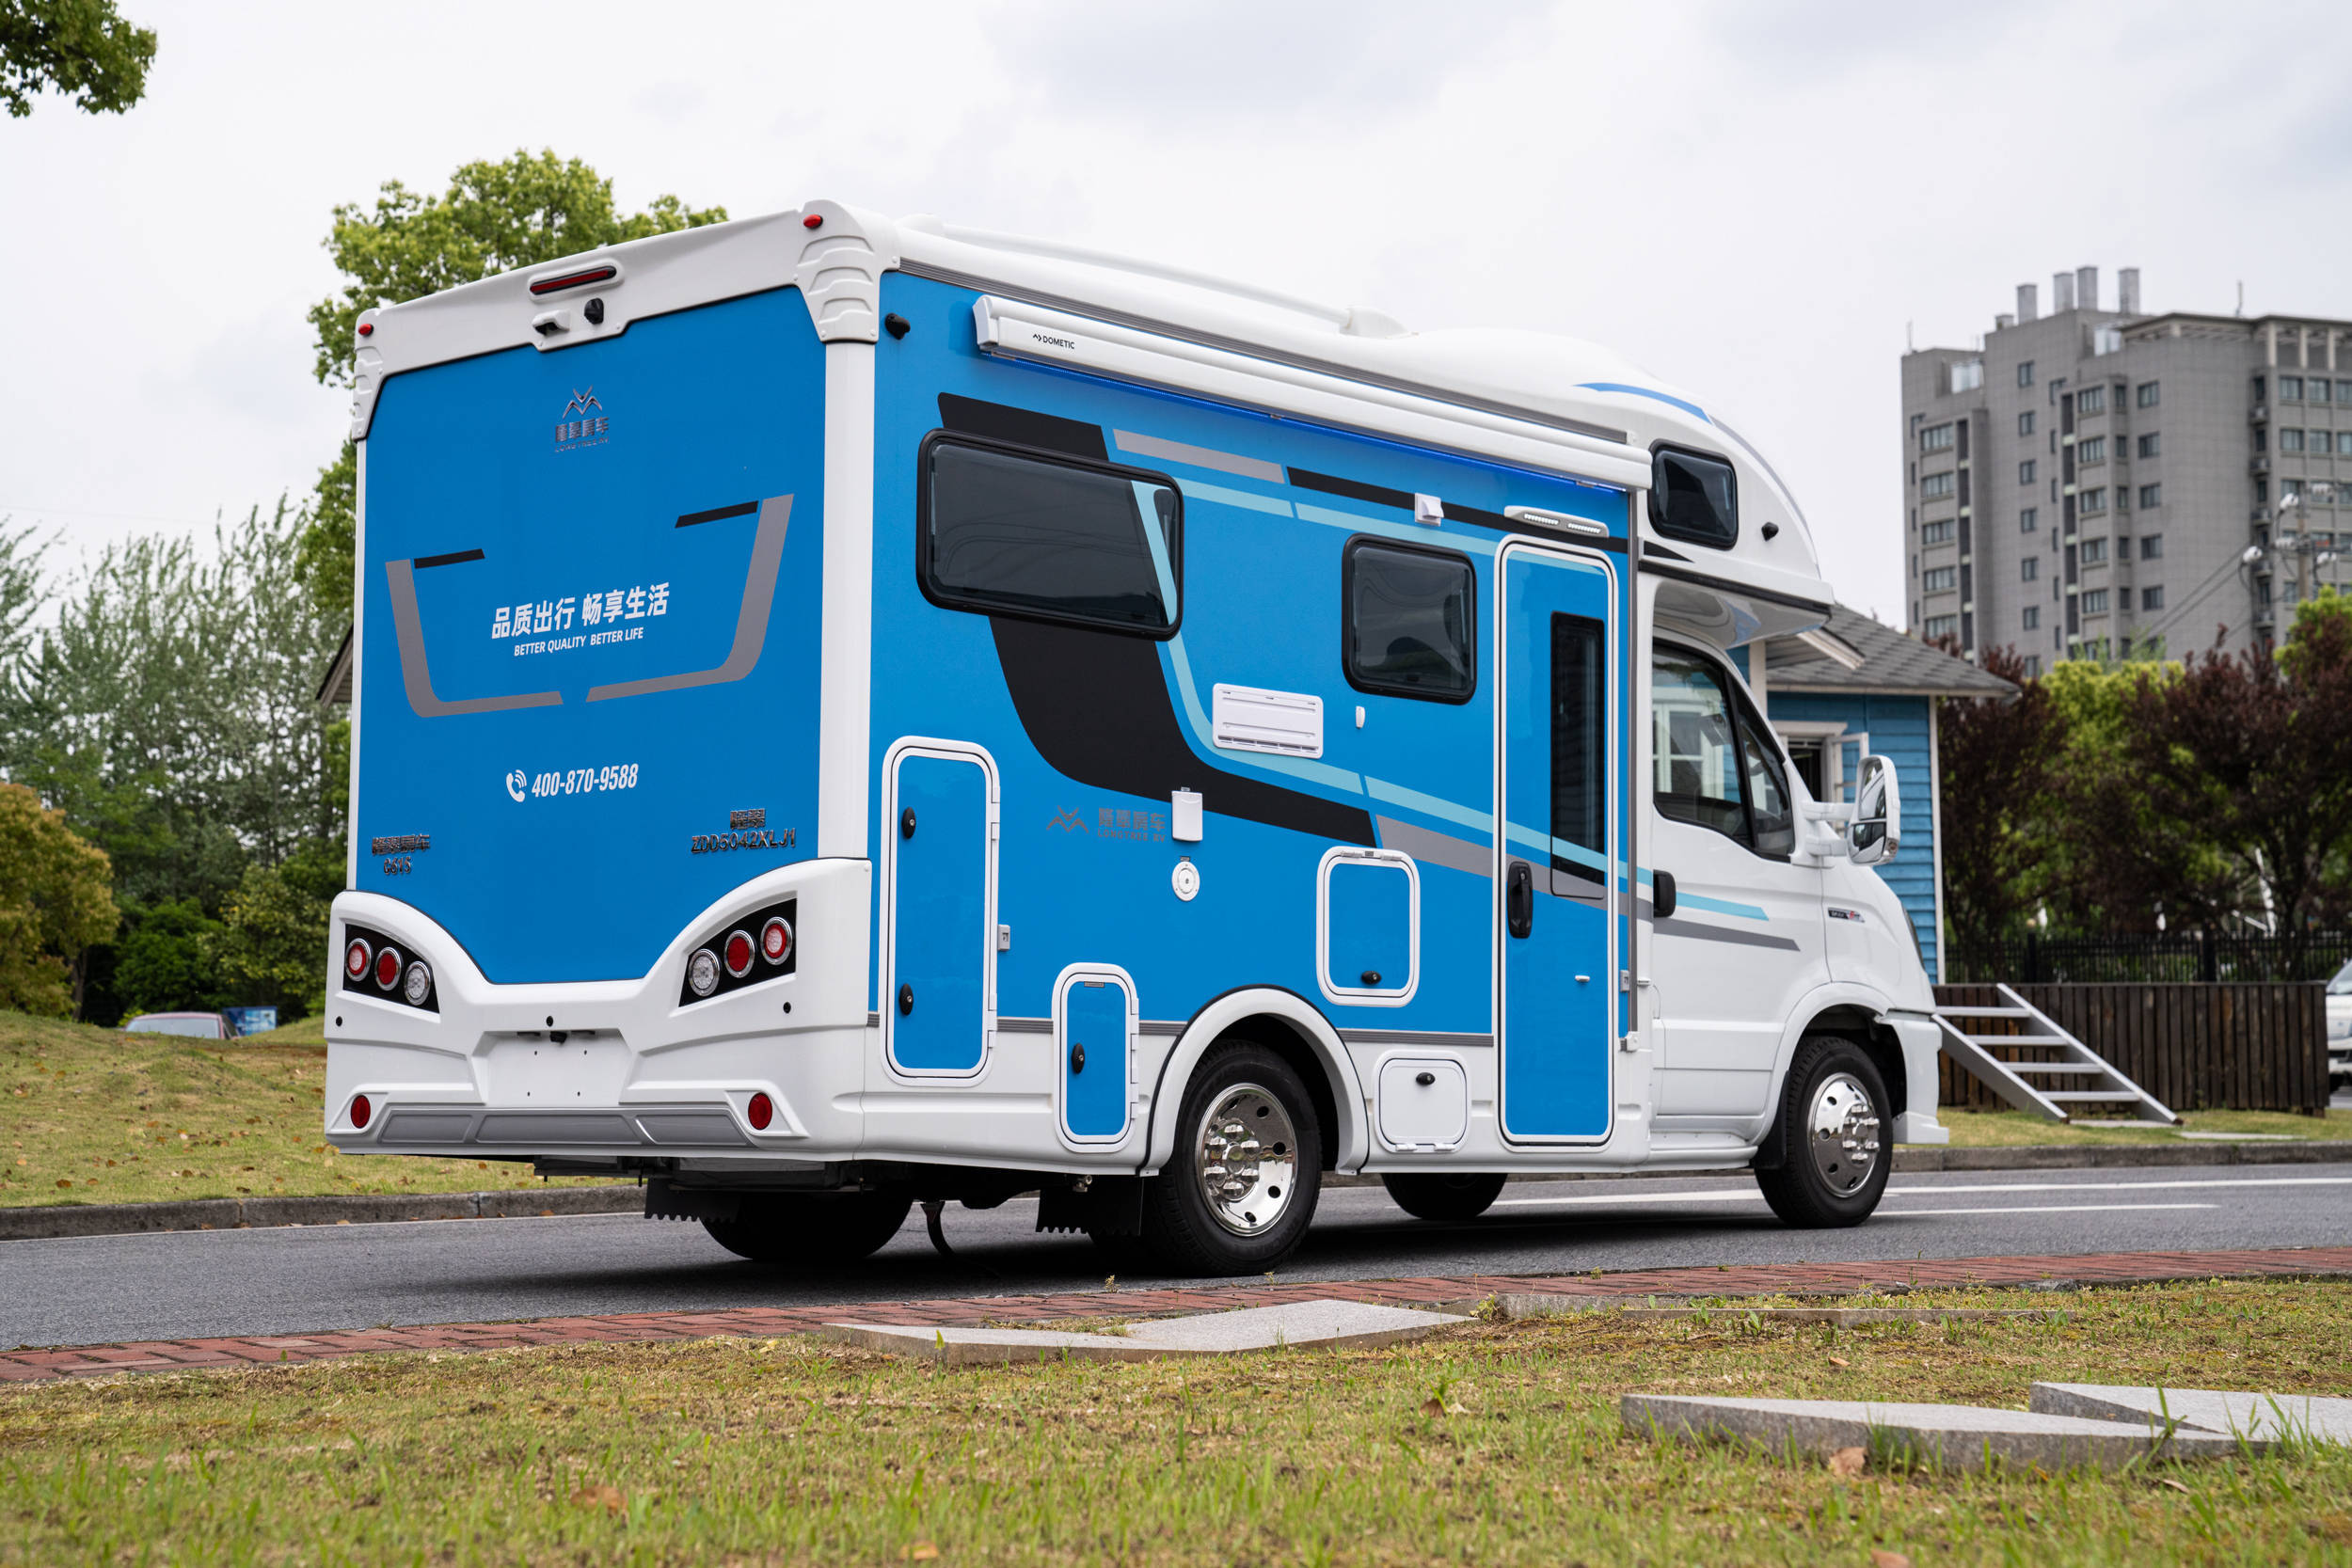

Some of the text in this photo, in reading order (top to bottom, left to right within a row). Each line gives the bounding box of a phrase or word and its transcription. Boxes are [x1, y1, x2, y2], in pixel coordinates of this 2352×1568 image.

[1042, 335, 1075, 350] DOMETIC
[491, 582, 670, 640] 品质出行 畅享生活
[514, 626, 644, 657] BETTER QUALITY BETTER LIFE
[531, 763, 639, 798] 400-870-9588
